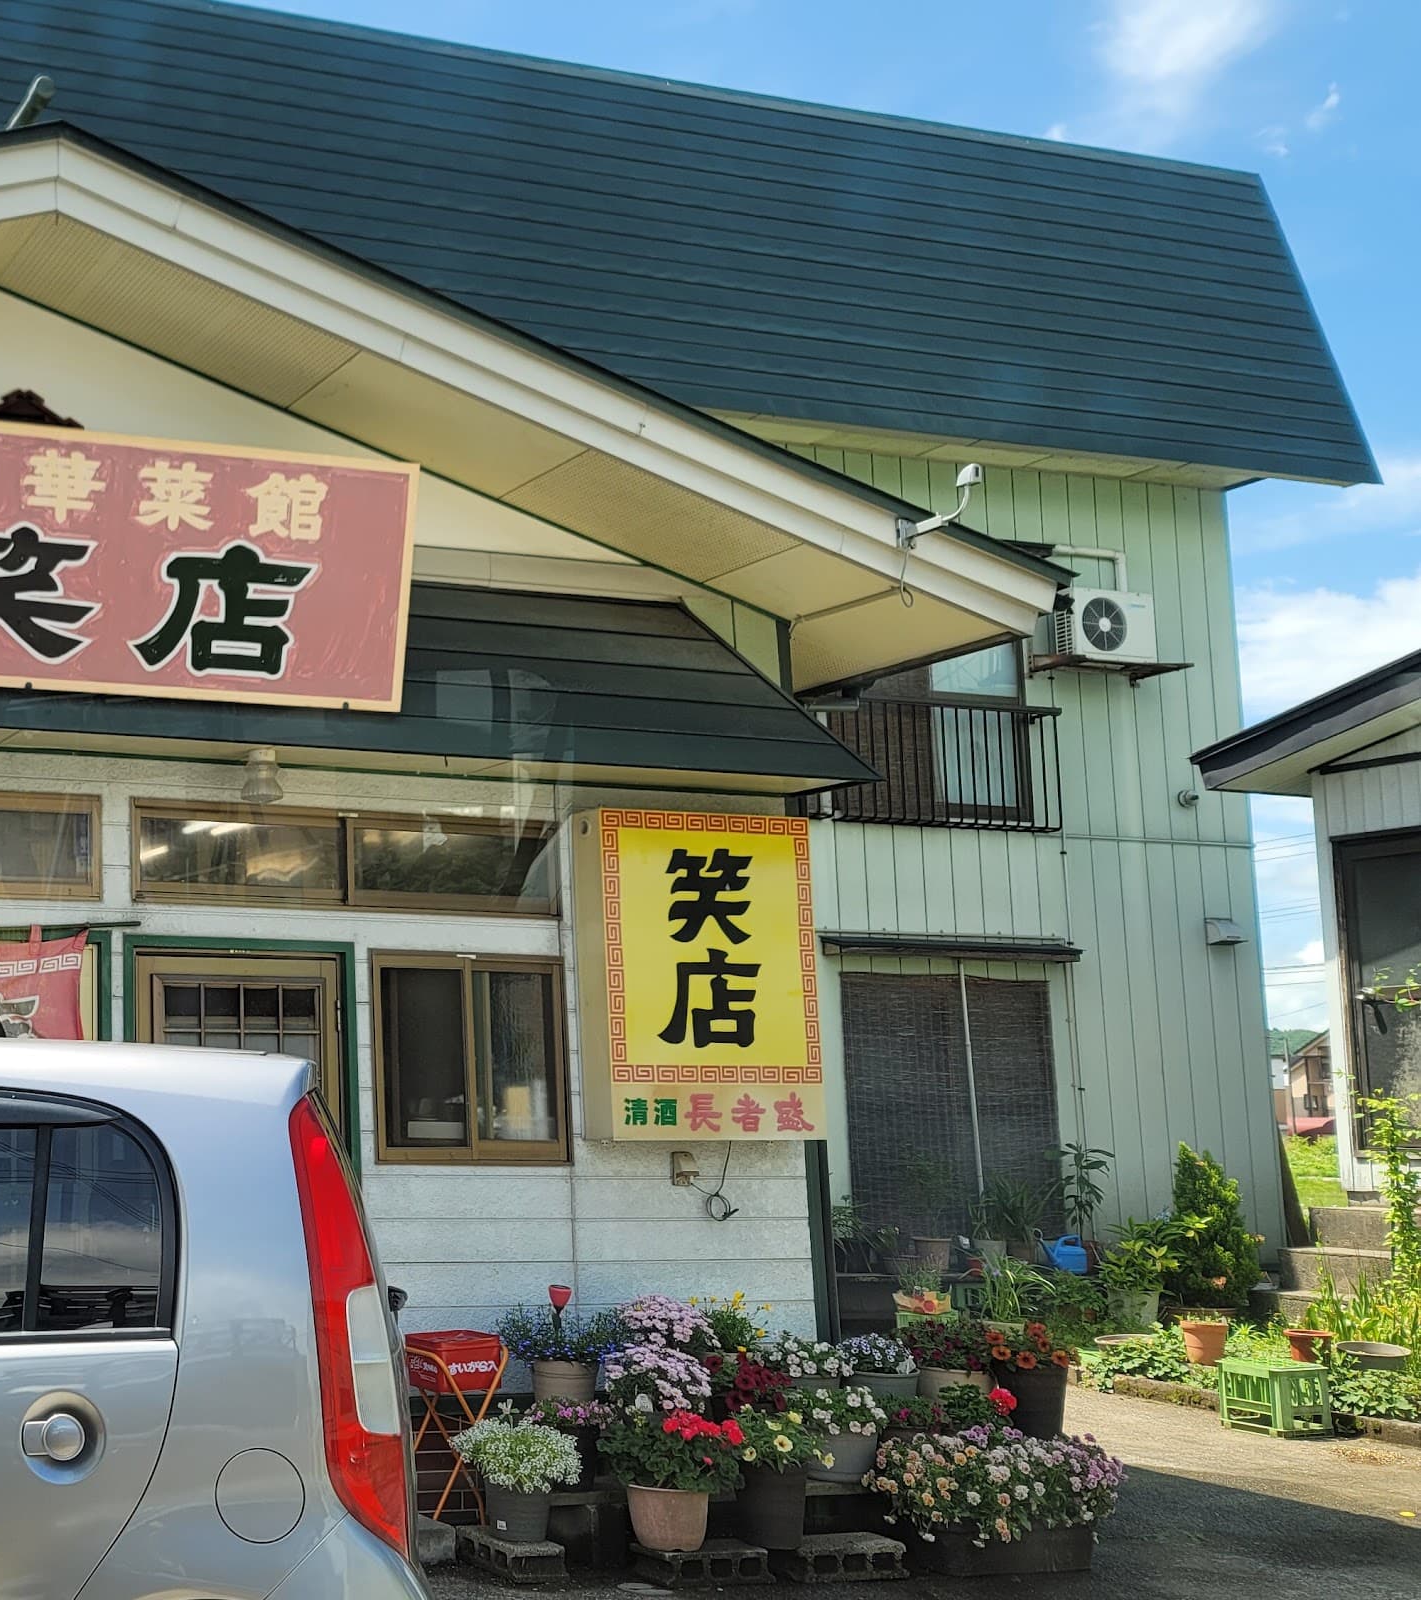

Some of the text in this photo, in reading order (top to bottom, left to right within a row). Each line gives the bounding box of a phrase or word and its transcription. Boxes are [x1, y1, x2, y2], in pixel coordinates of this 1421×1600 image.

[657, 848, 762, 1049] 笑店
[624, 1091, 815, 1133] 清酒 長者盛
